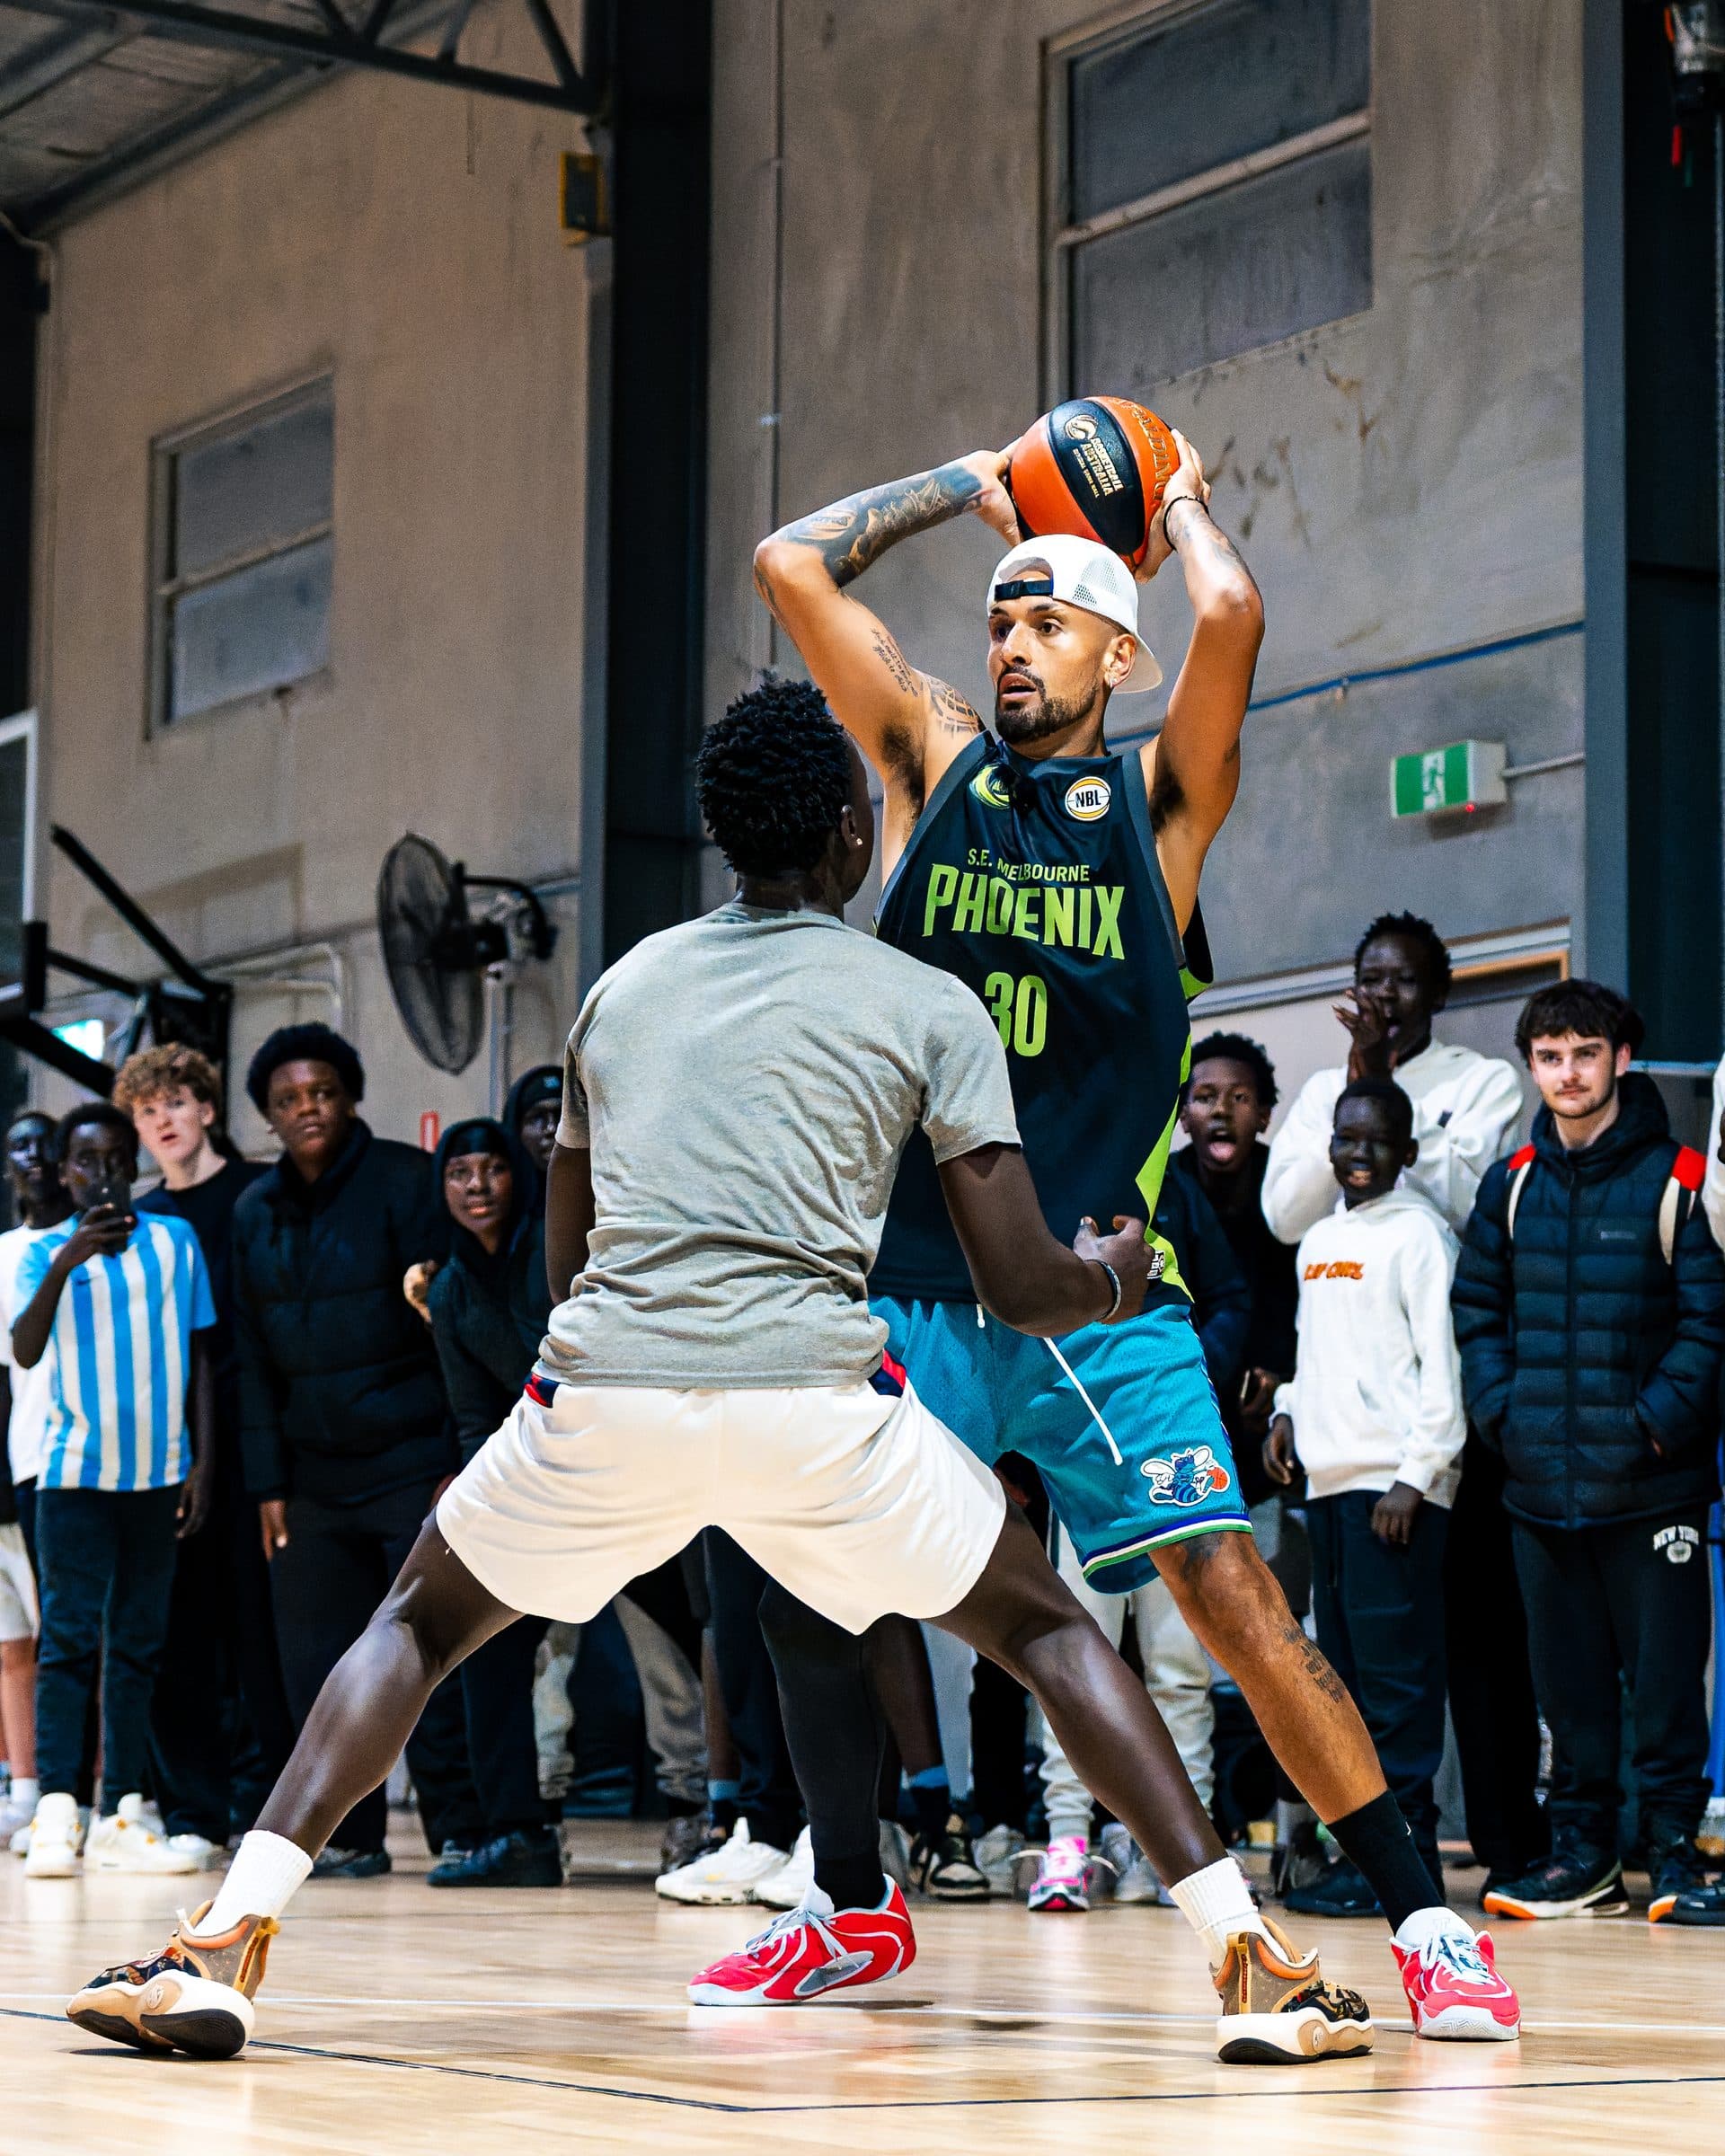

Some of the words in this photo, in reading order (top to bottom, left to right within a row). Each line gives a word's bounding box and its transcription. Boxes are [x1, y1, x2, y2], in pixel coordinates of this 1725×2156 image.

[1080, 443, 1114, 496] AUSTRALIA
[1075, 789, 1101, 808] NBL
[968, 848, 993, 867] S.E.
[997, 857, 1091, 882] MELBOURNE
[922, 863, 1125, 960] PHOENIX
[985, 971, 1048, 1057] 30
